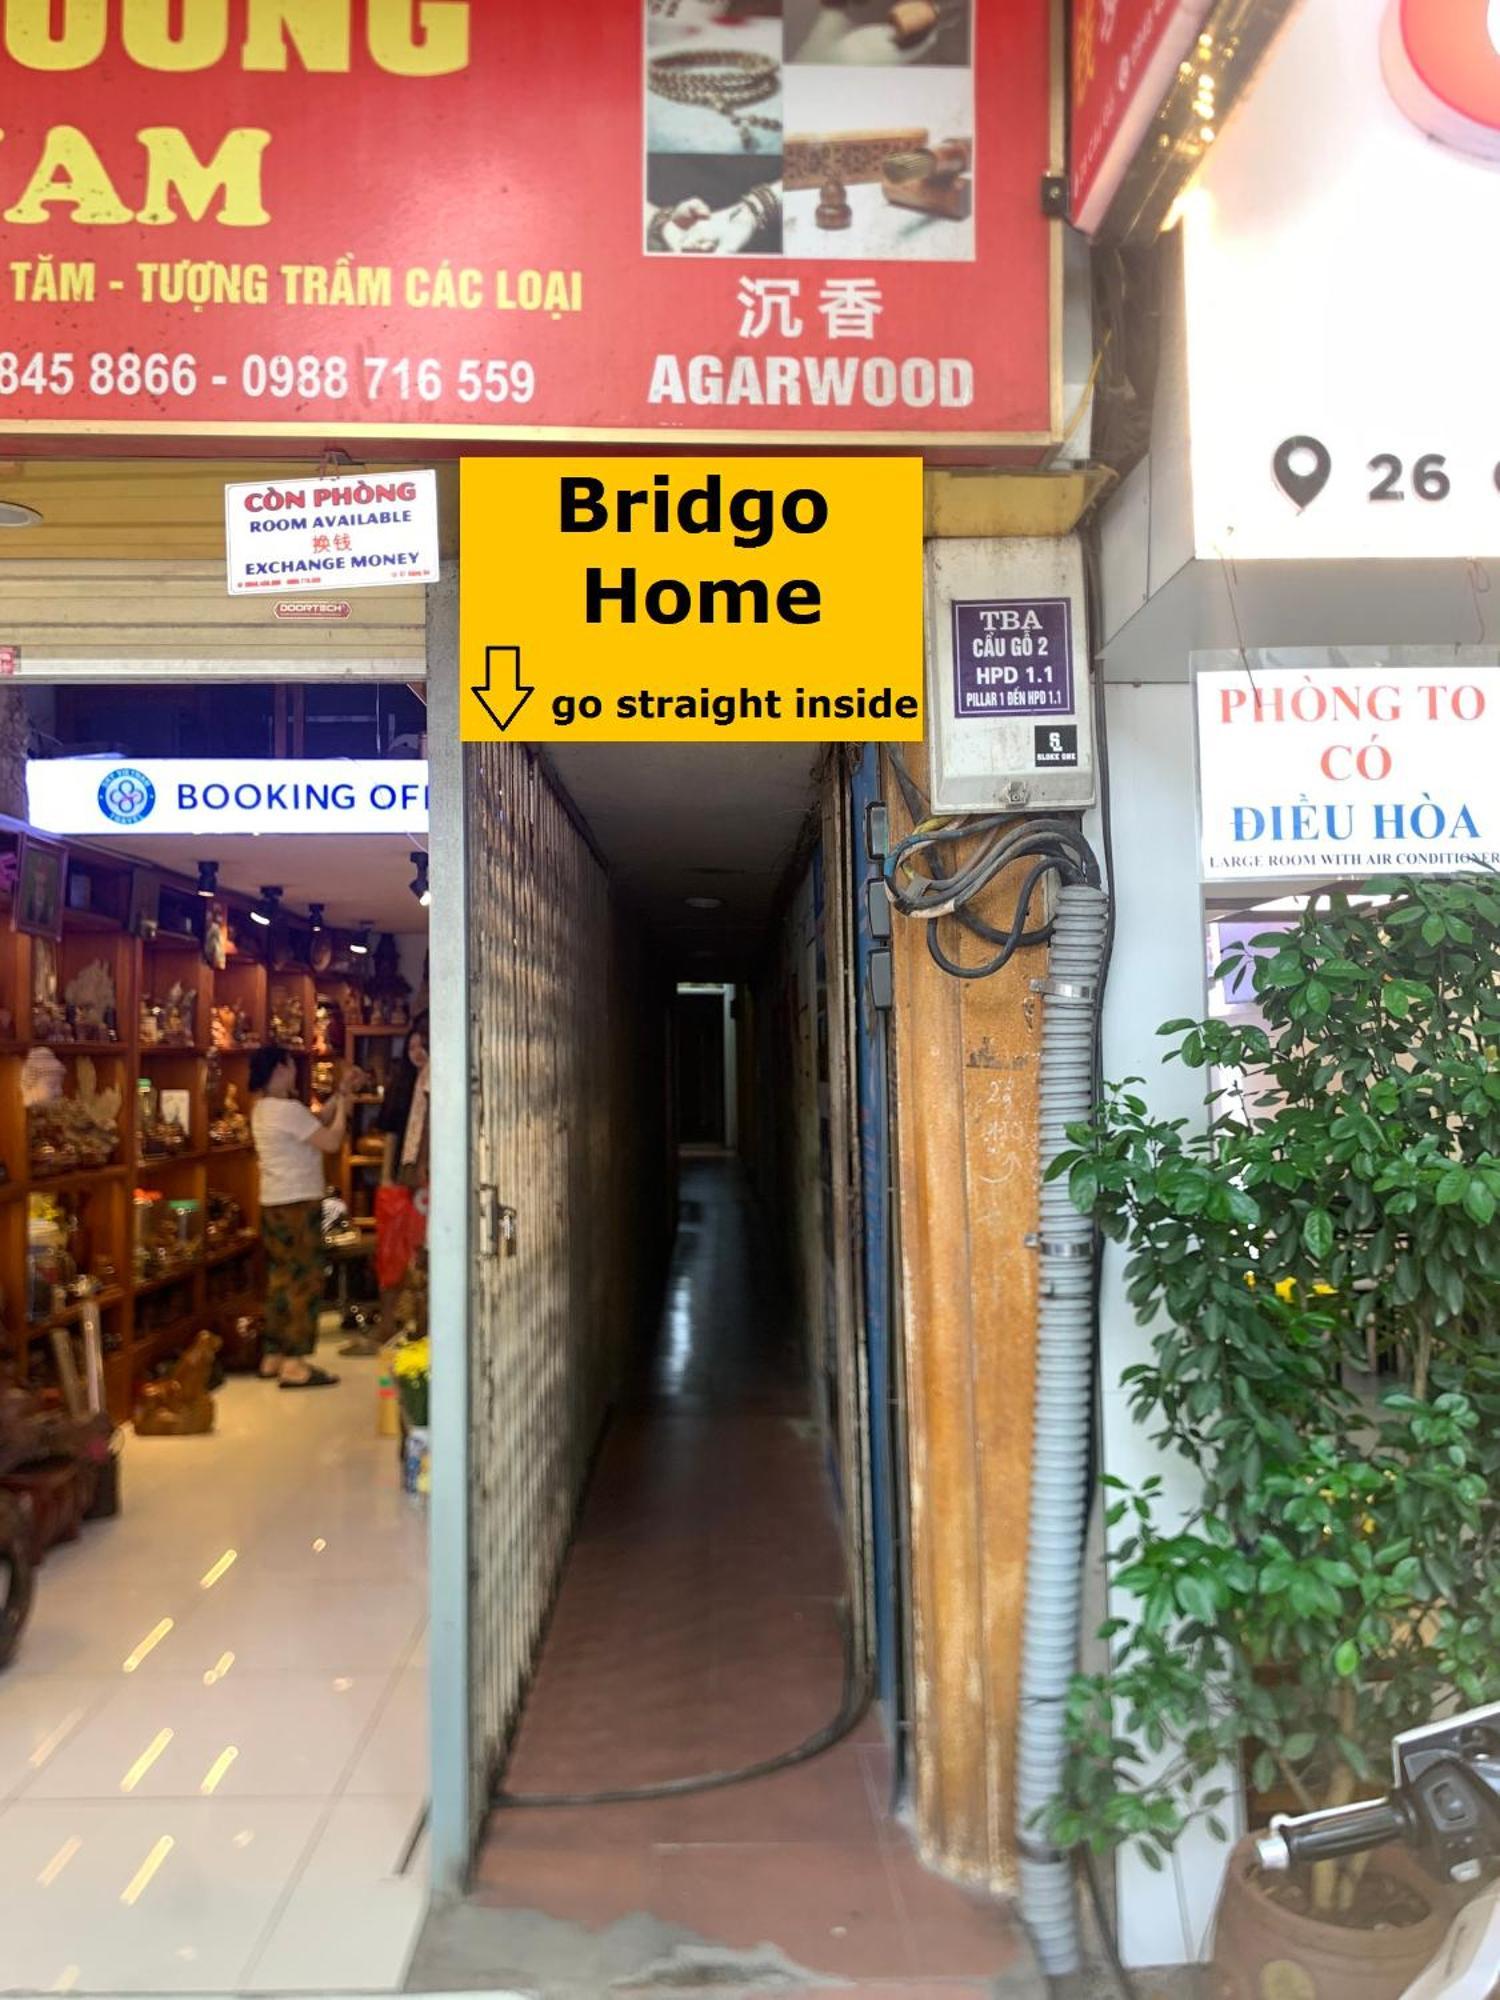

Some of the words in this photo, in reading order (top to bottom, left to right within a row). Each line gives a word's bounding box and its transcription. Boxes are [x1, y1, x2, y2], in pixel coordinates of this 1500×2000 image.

[0, 125, 272, 227] AM
[11, 255, 95, 303] TĂM
[137, 260, 268, 312] TƯỢNG
[281, 252, 392, 307] TRẦM
[405, 260, 483, 309] CÁC
[498, 271, 582, 320] LOẠI
[737, 276, 883, 339] 沉香
[89, 352, 198, 397] 8866
[242, 354, 349, 399] 0988
[364, 358, 441, 401] 716
[457, 360, 535, 403] 559
[647, 354, 974, 408] AGARWOOD
[244, 487, 306, 513] CÒN
[314, 480, 417, 508] PHÒNG
[1368, 453, 1451, 502] 26
[250, 518, 307, 533] ROOM
[313, 510, 412, 529] AVAILABLE
[245, 557, 345, 576] EXCHANGE
[351, 552, 420, 569] MONEY
[980, 610, 1044, 631] TBA
[973, 631, 1006, 658] CẦU
[1038, 636, 1049, 656] 2
[976, 666, 1019, 685] HPD
[1025, 665, 1053, 683] 1.1
[966, 691, 998, 707] PILLAR
[1028, 690, 1046, 705] HPD
[1219, 675, 1401, 724] PHÒNG
[1418, 685, 1486, 722] TO
[1320, 734, 1393, 781] CÓ
[177, 783, 356, 810] BOOKING
[370, 784, 429, 810] OF
[1230, 793, 1355, 842] ĐIỀU
[1373, 792, 1482, 840] HÒA
[1209, 856, 1266, 869] LARGE
[1268, 854, 1316, 867] ROOM
[1320, 853, 1362, 866] WITH
[1365, 852, 1393, 866] AIR
